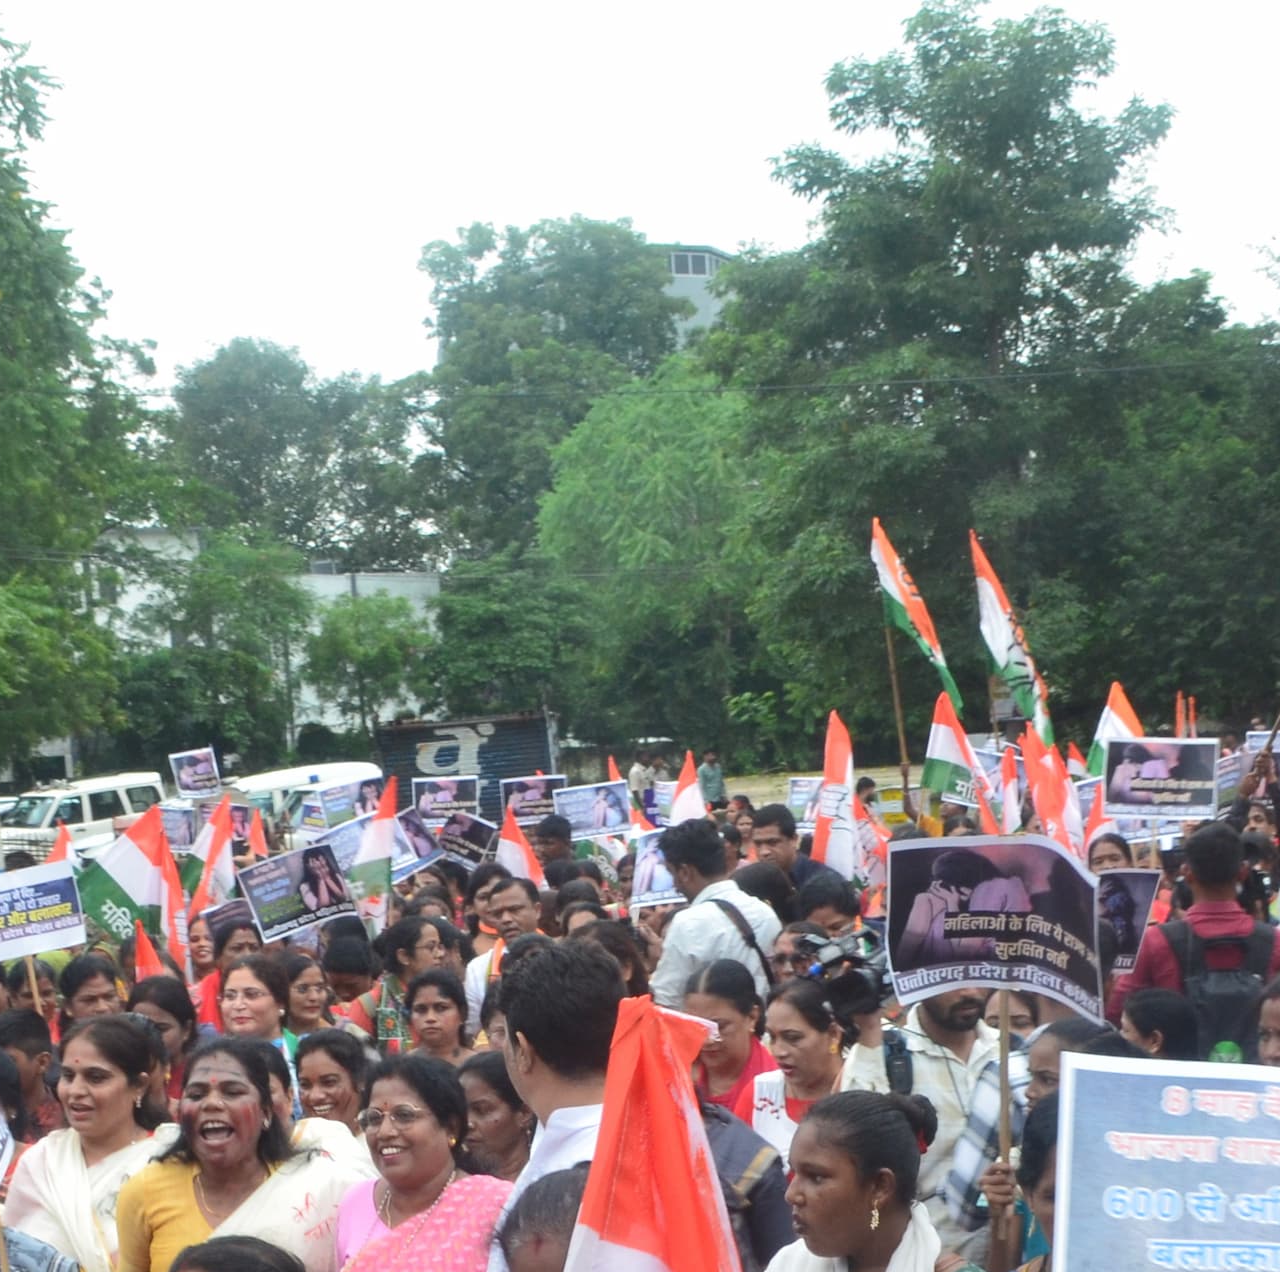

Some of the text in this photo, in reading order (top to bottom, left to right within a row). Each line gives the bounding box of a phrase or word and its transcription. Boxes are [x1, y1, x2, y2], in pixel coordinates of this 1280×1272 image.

[1009, 914, 1023, 931] के
[968, 962, 1007, 981] प्रदेश
[1012, 964, 1061, 990] महिला
[1161, 1085, 1191, 1116] 8
[1192, 1089, 1259, 1122] माह
[1105, 1131, 1220, 1163] भाजपा
[1103, 1184, 1183, 1222] 600
[1186, 1182, 1229, 1223] से
